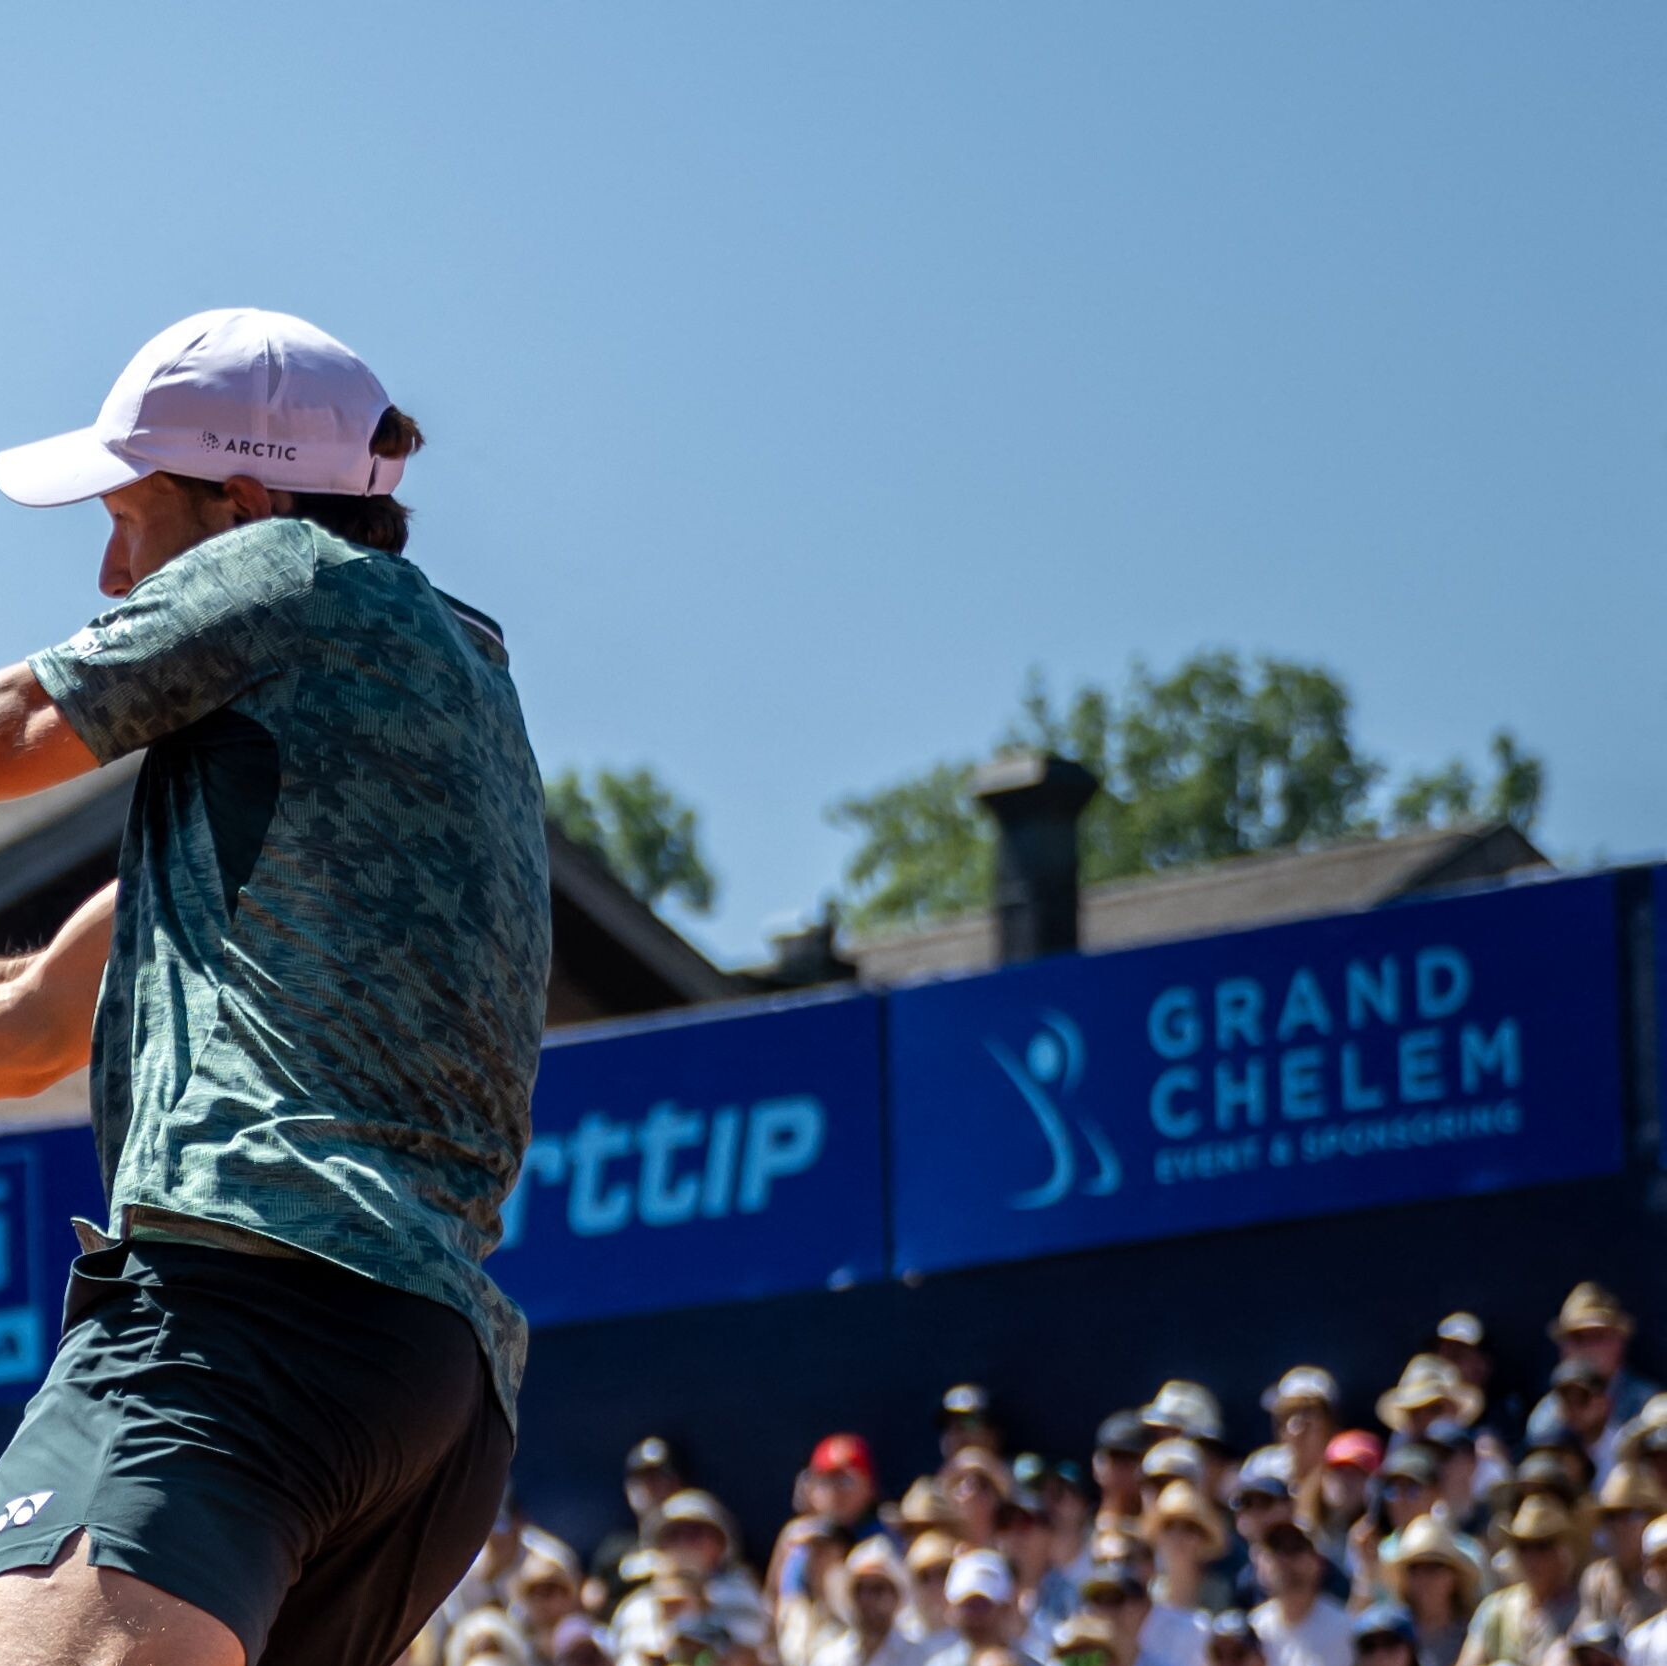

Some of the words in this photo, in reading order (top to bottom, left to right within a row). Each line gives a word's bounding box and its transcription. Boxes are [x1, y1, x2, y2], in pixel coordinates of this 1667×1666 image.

[224, 437, 298, 461] ARCTIC
[1148, 945, 1471, 1060] GRAND
[1149, 1016, 1523, 1140] CHELEM
[1154, 1134, 1259, 1184] EVENT
[1301, 1100, 1522, 1163] SPONSORING
